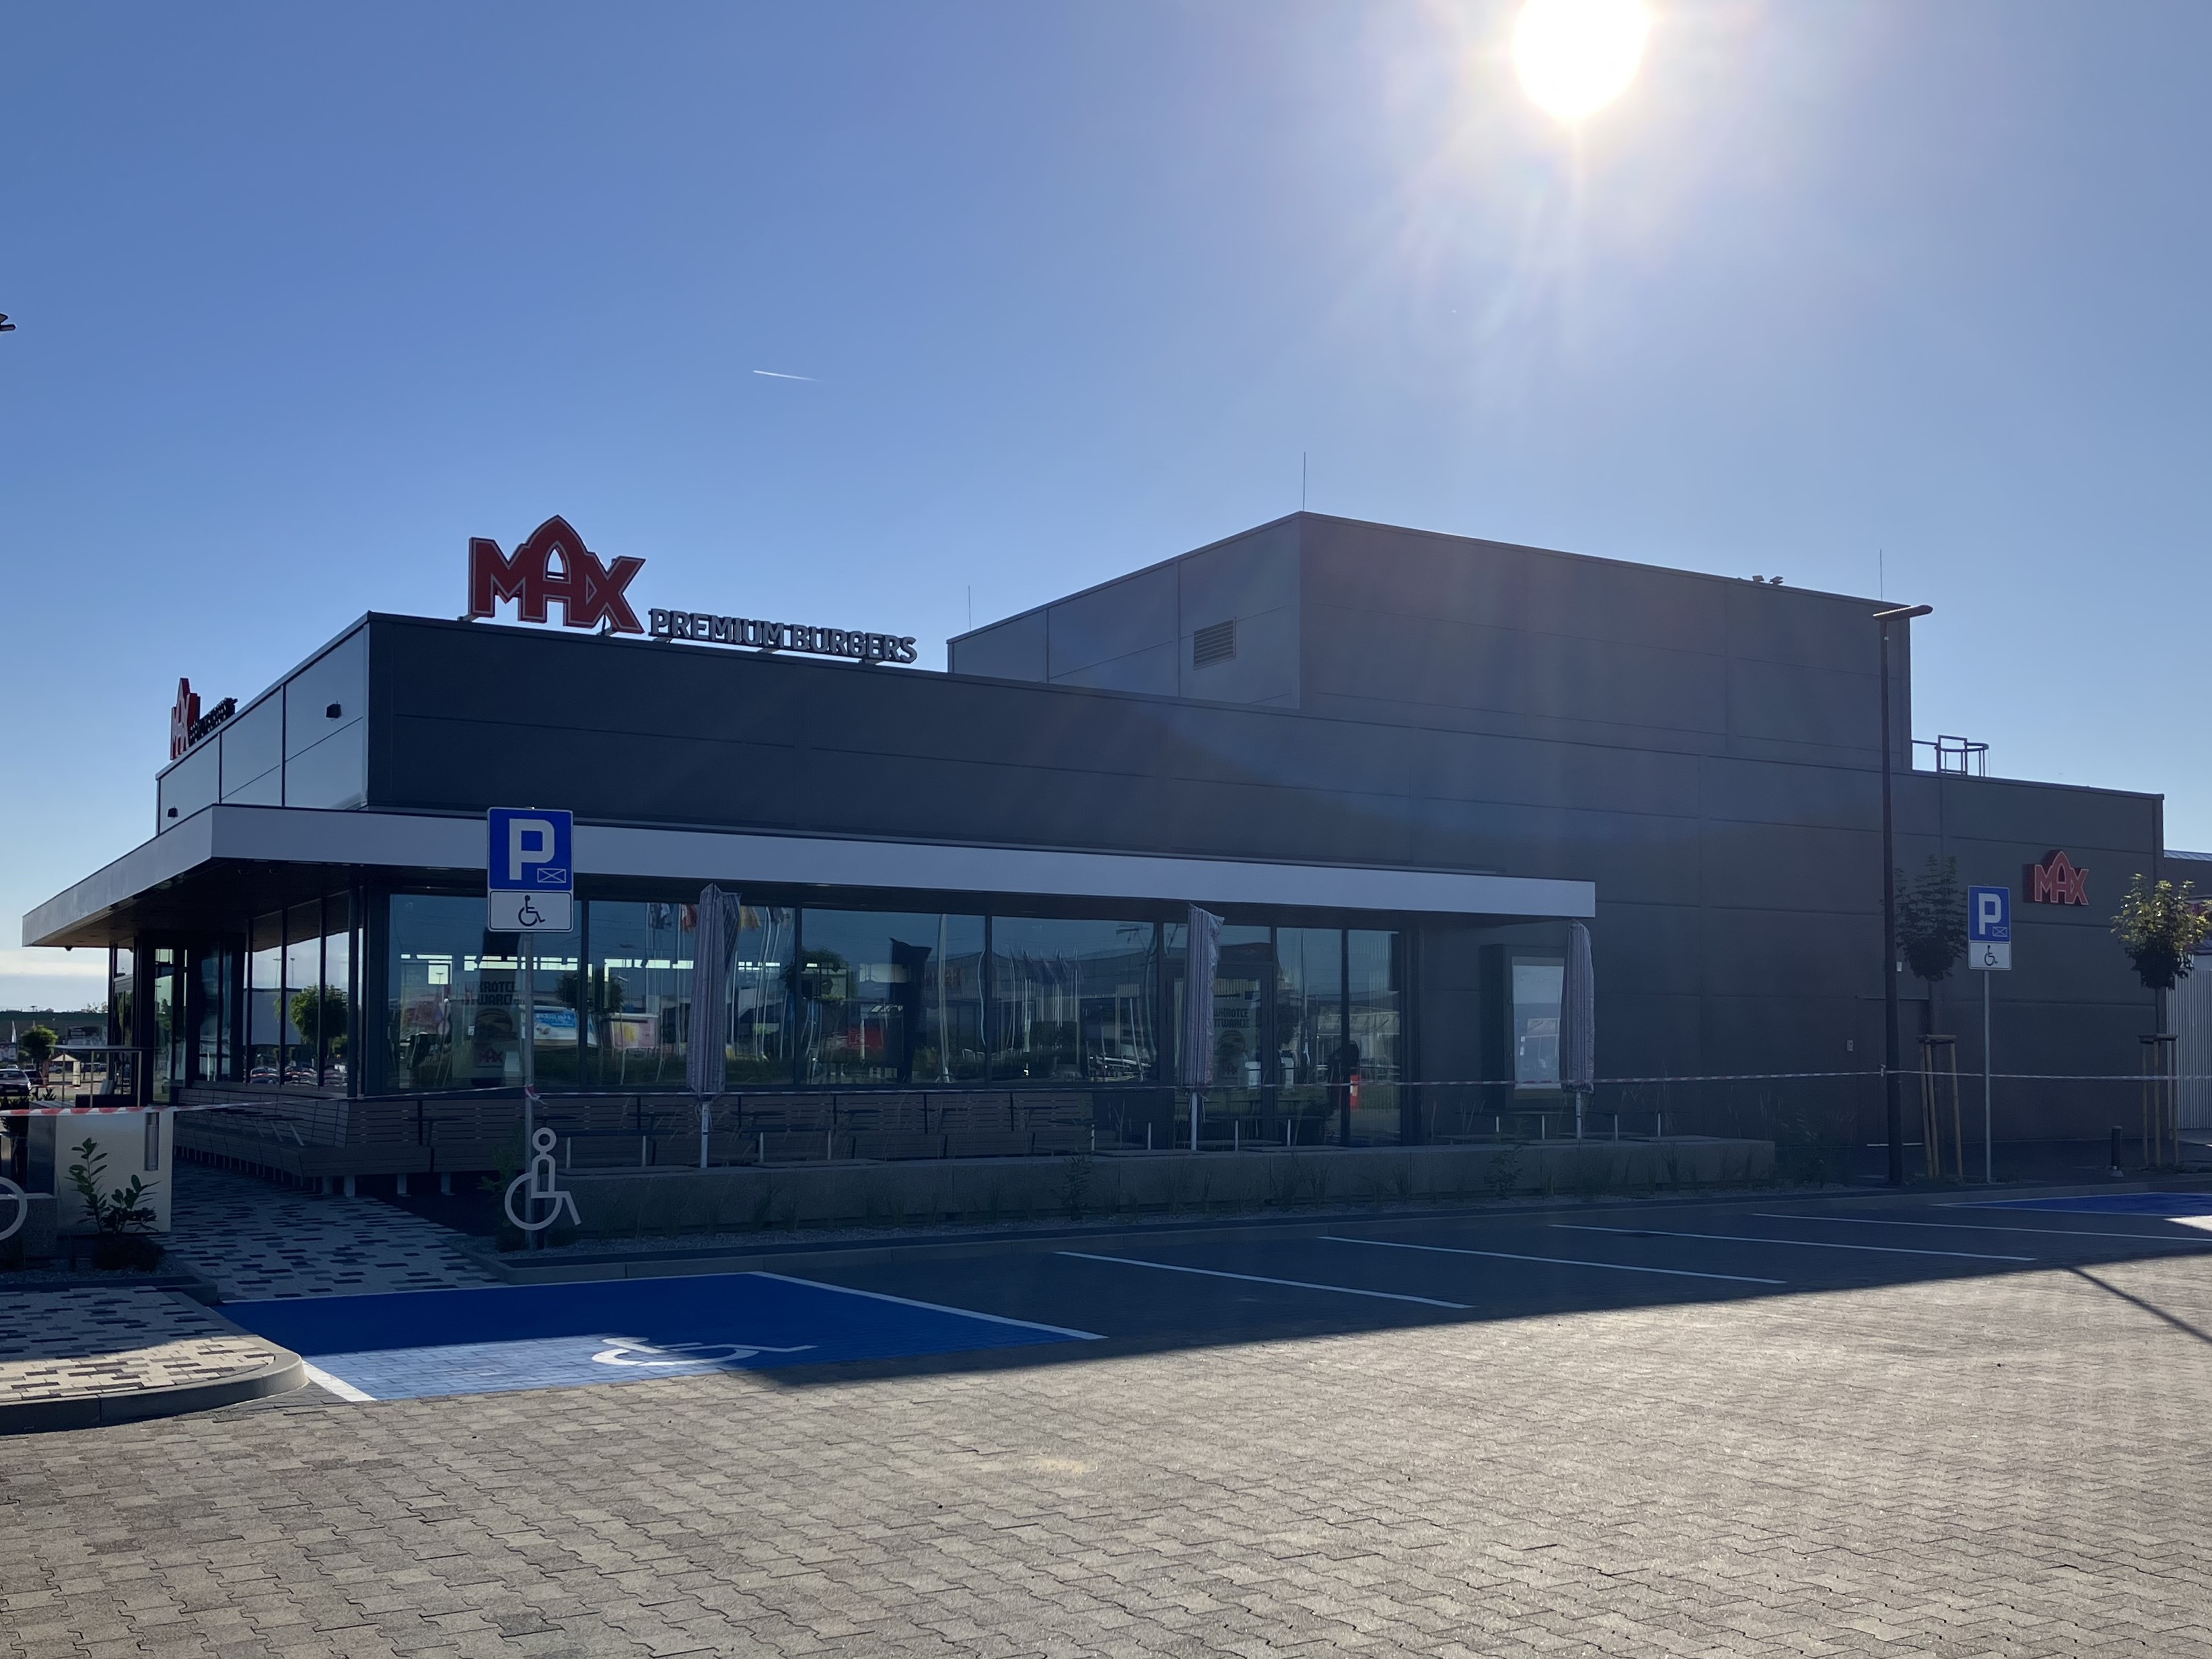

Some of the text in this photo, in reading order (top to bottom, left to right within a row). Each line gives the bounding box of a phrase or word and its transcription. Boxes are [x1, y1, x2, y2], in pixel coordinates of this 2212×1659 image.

[468, 514, 646, 634] MAX
[649, 608, 918, 664] PREMIUM BURGERS
[509, 818, 555, 880] P
[2033, 850, 2090, 905] MAX
[1978, 892, 2001, 935] P
